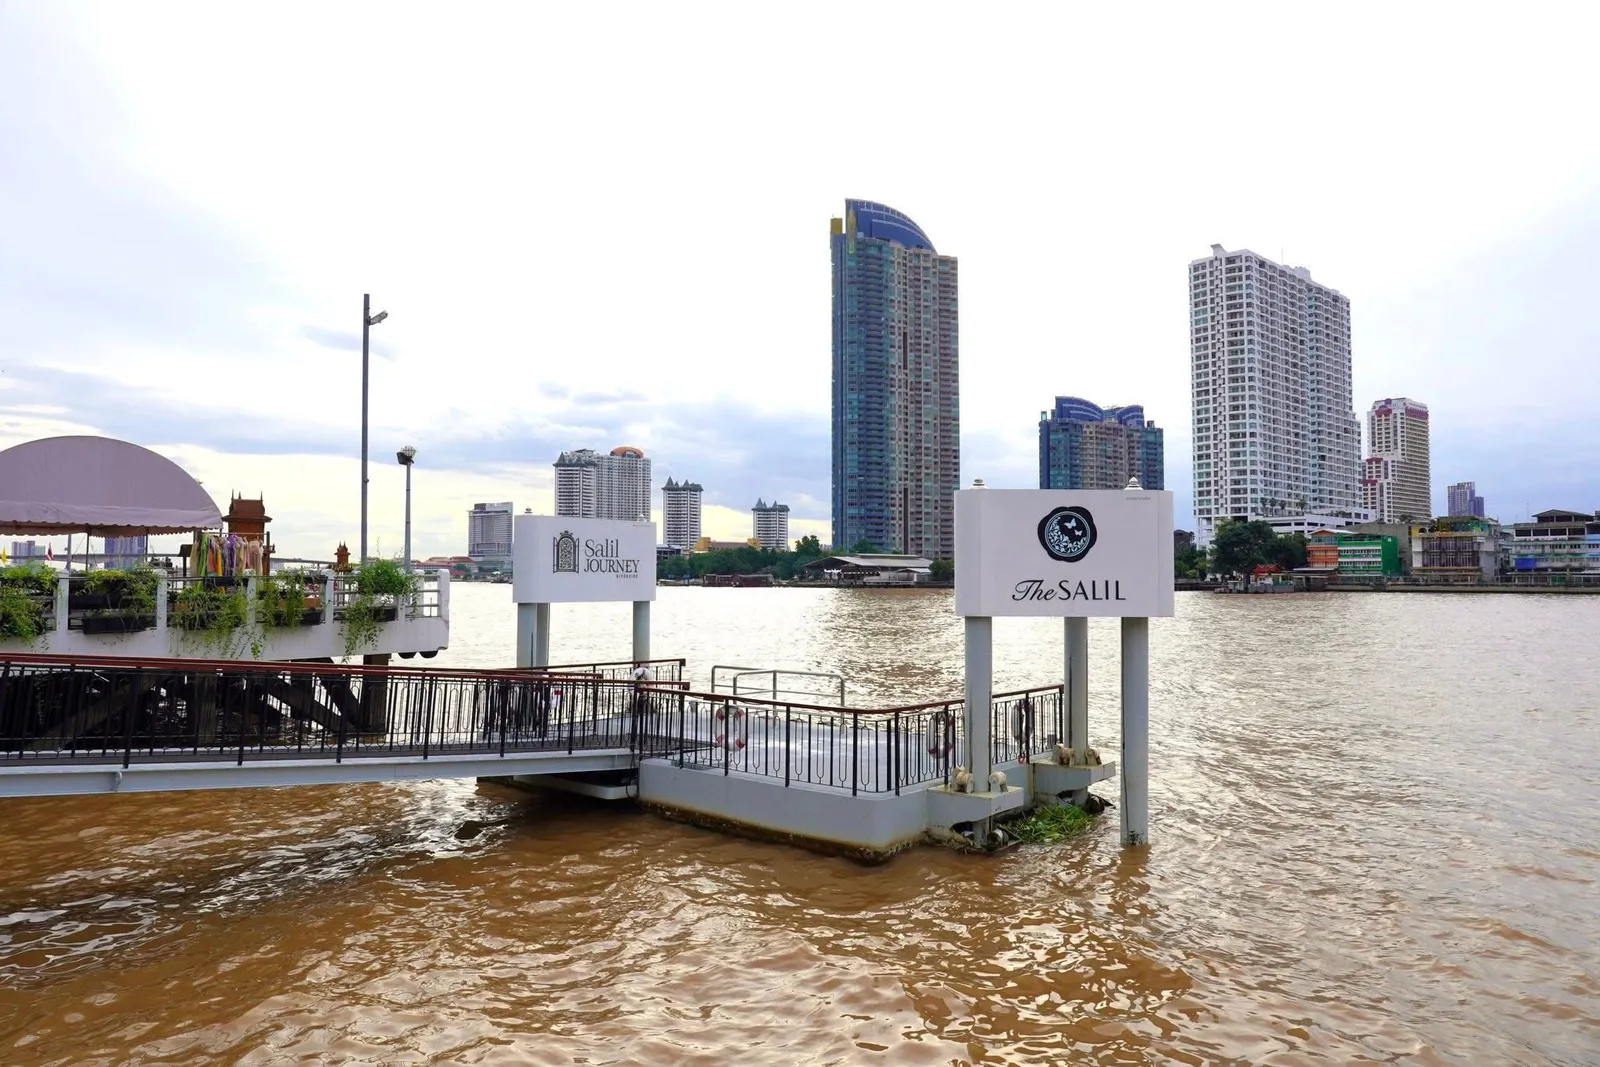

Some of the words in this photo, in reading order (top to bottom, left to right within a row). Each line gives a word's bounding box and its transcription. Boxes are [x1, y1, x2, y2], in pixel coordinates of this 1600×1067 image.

[584, 538, 619, 558] Salil
[583, 558, 640, 573] JOURNEY
[1011, 579, 1057, 601] The
[1058, 579, 1127, 601] SALIL
